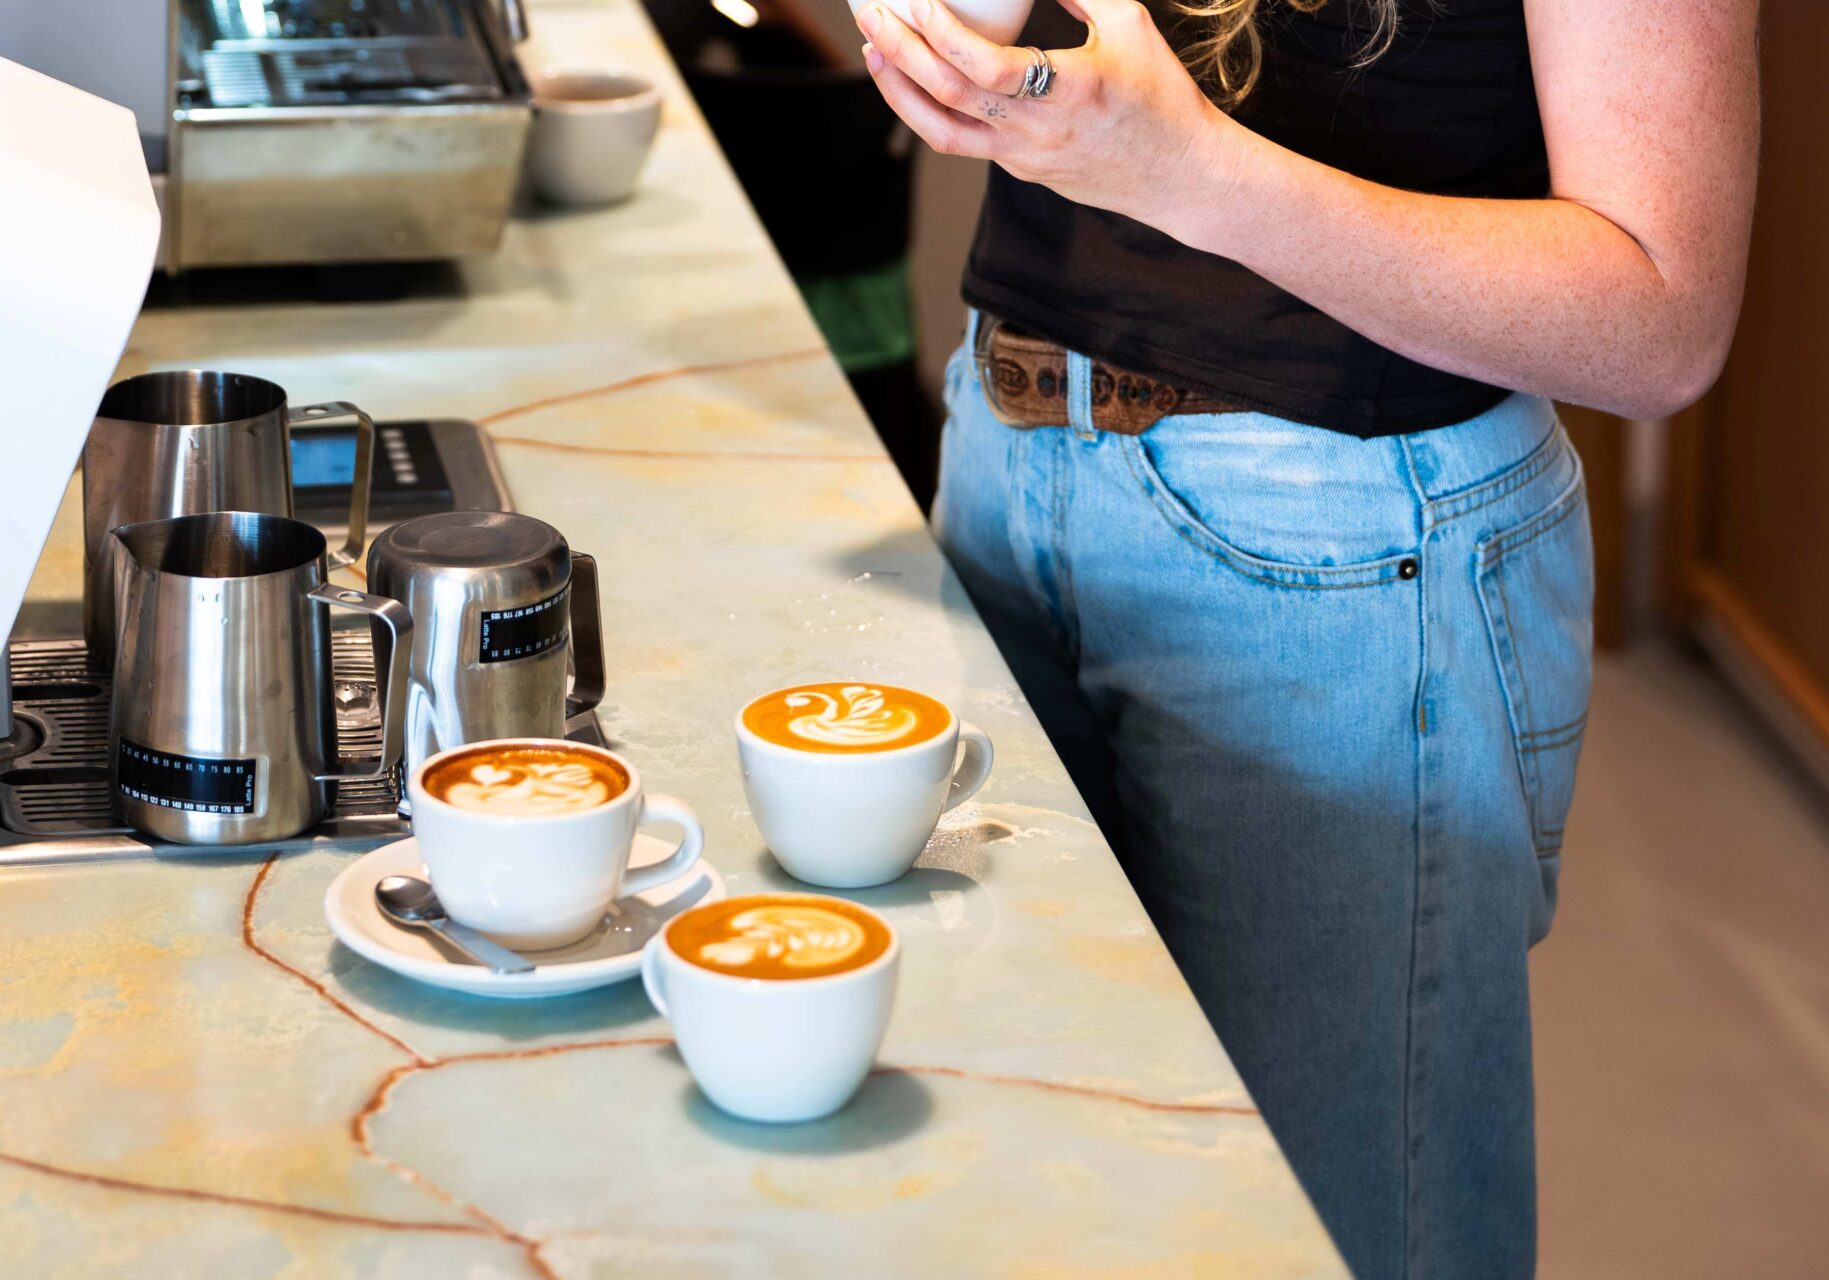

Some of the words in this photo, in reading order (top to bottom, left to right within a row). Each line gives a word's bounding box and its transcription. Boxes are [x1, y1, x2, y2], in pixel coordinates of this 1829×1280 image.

[186, 762, 193, 771] 65
[198, 764, 205, 772] 70
[211, 765, 218, 773] 75
